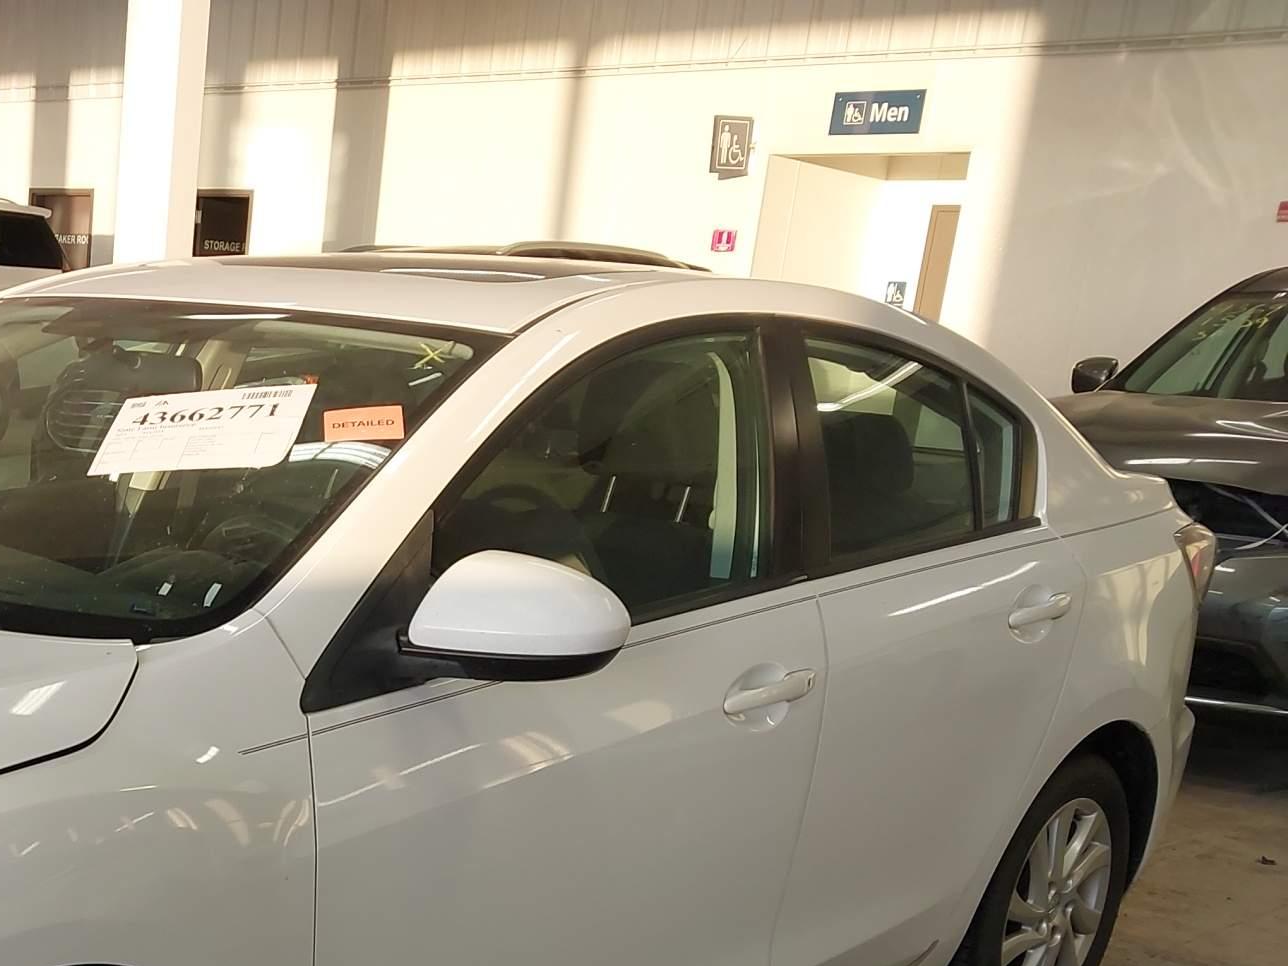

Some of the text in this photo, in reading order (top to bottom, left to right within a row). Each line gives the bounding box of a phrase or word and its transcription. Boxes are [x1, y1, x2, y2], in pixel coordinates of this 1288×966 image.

[869, 103, 909, 122] Men
[204, 240, 240, 252] STORAGE
[132, 402, 281, 427] 43662771
[332, 419, 395, 429] DETAILED
